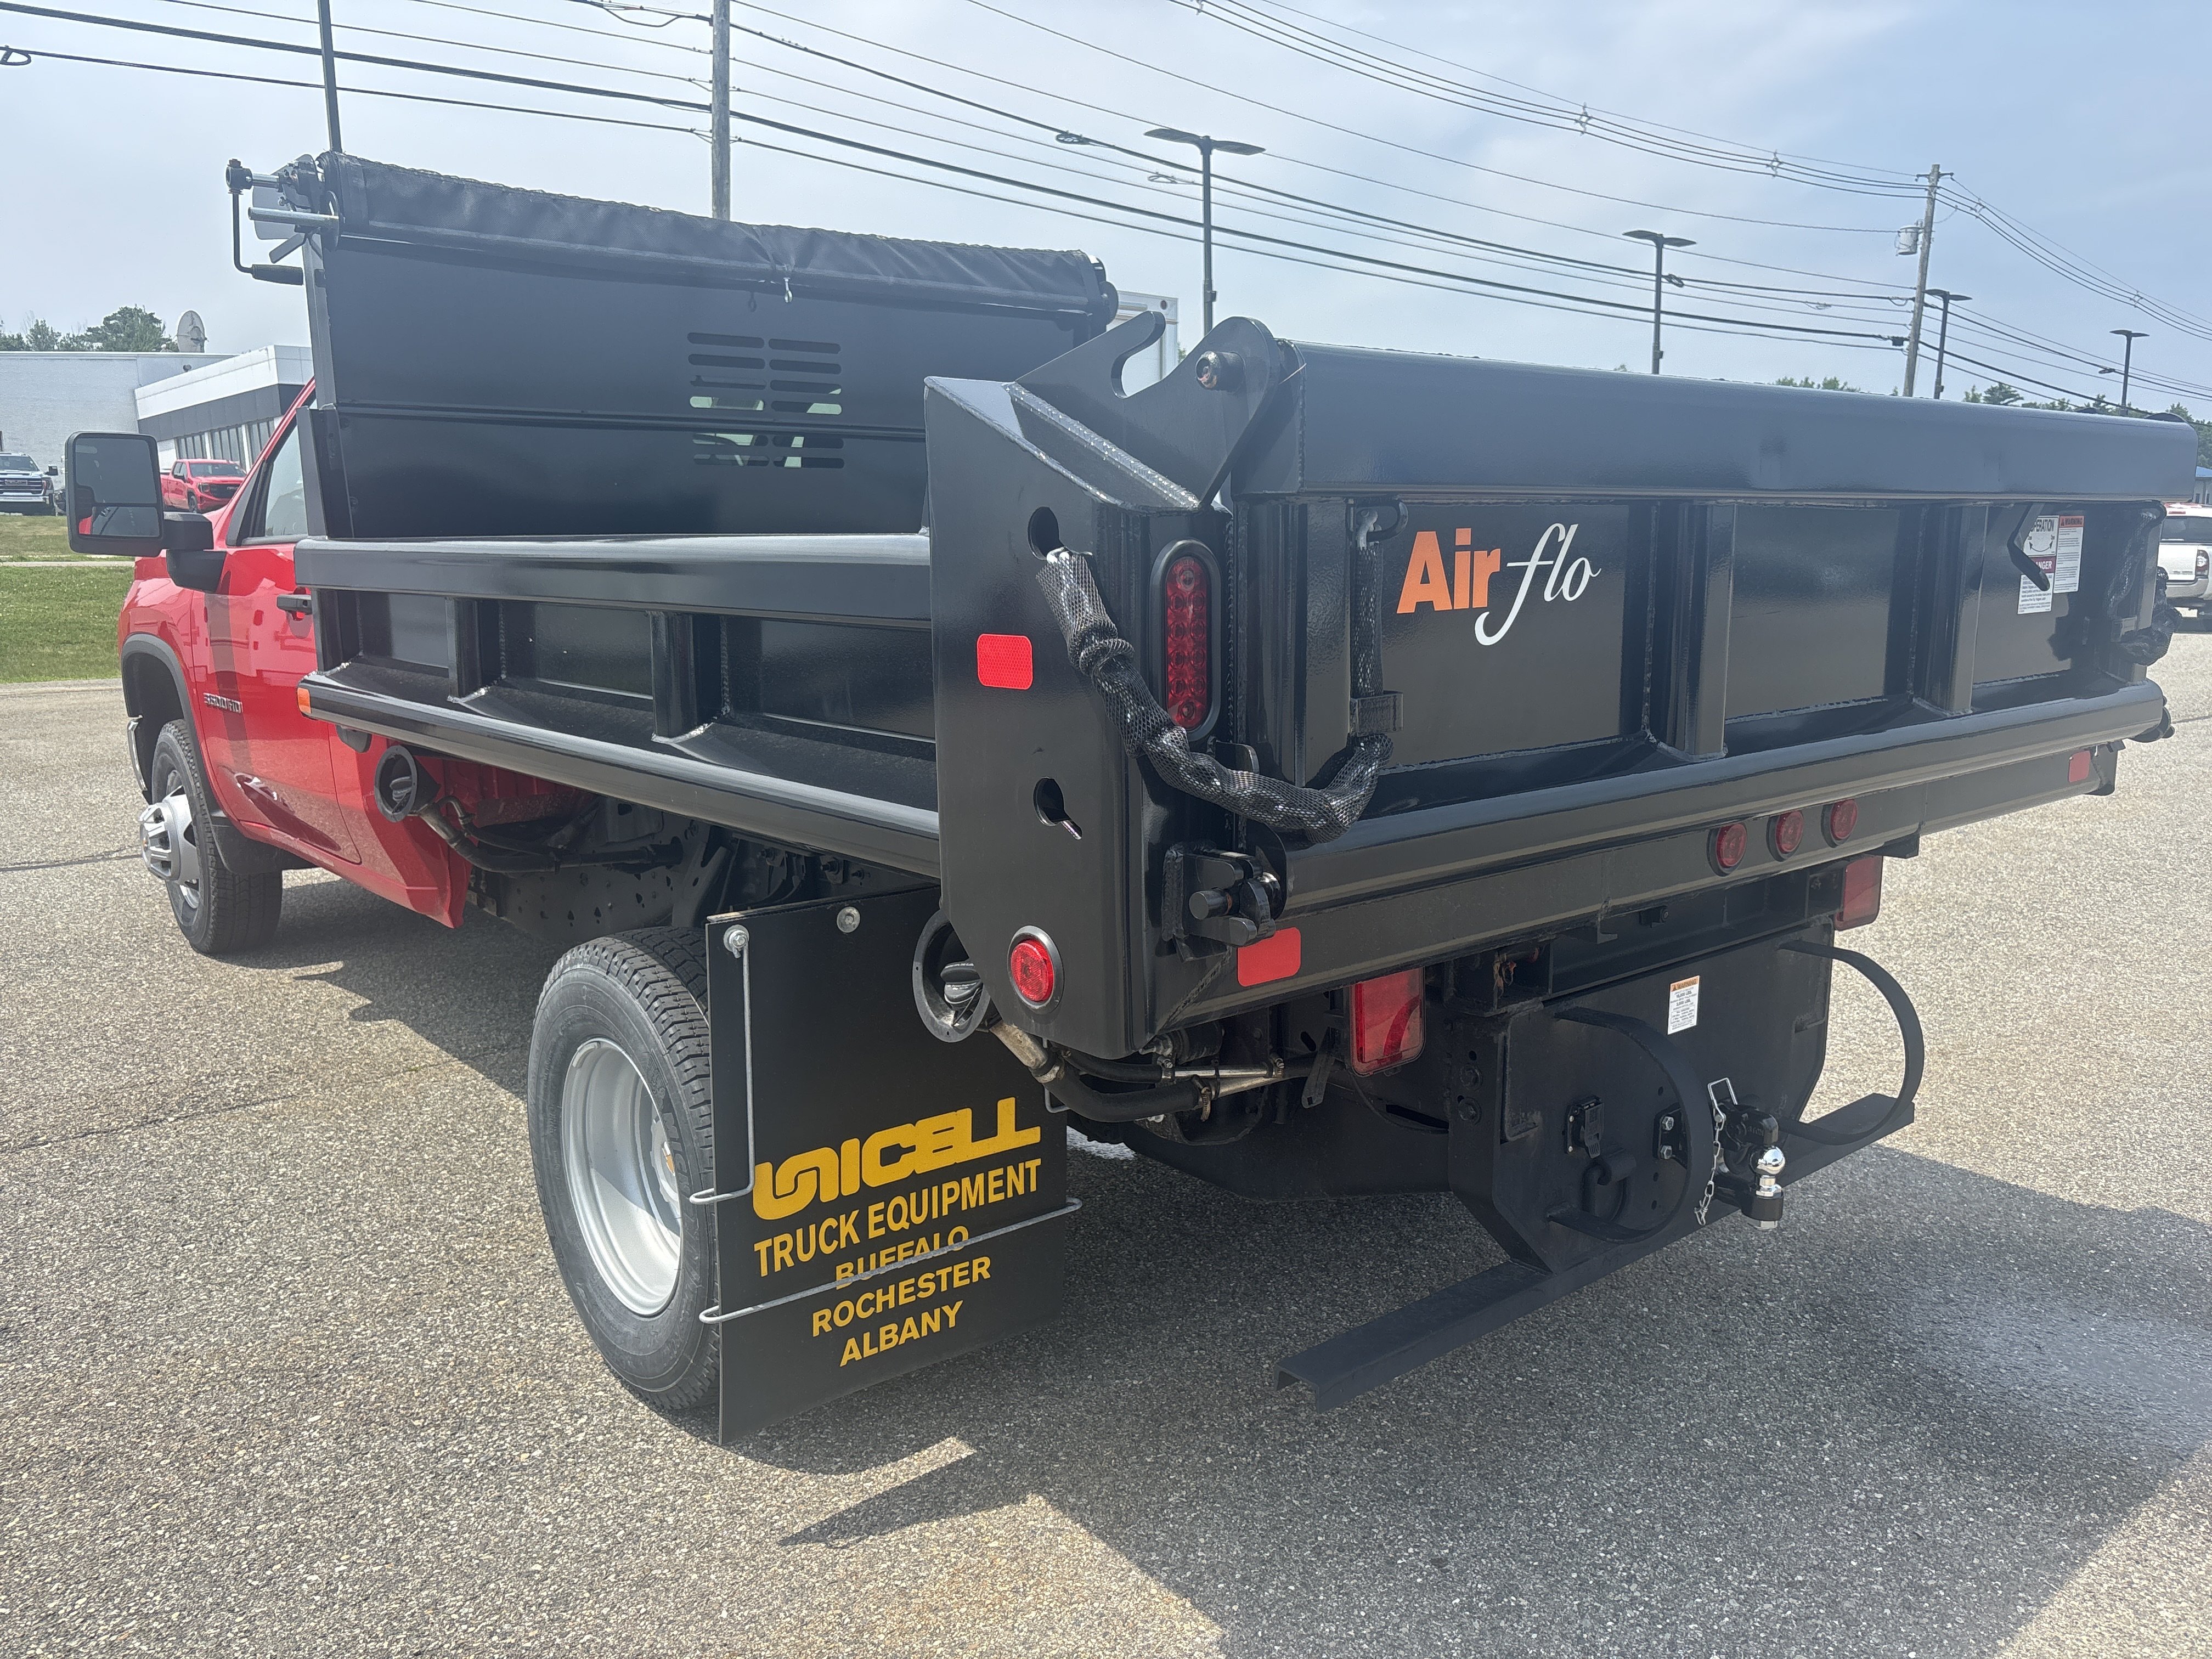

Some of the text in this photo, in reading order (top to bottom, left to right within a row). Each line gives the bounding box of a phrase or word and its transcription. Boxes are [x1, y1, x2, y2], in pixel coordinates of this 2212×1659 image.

[2035, 561, 2052, 570] ANGER
[752, 1097, 1041, 1220] UNICELL
[754, 1158, 1042, 1277] TRUCK EQUIPMENT
[835, 1225, 969, 1290] BUFFALO
[812, 1256, 991, 1338] ROCHESTER
[839, 1300, 964, 1367] ALBANY
